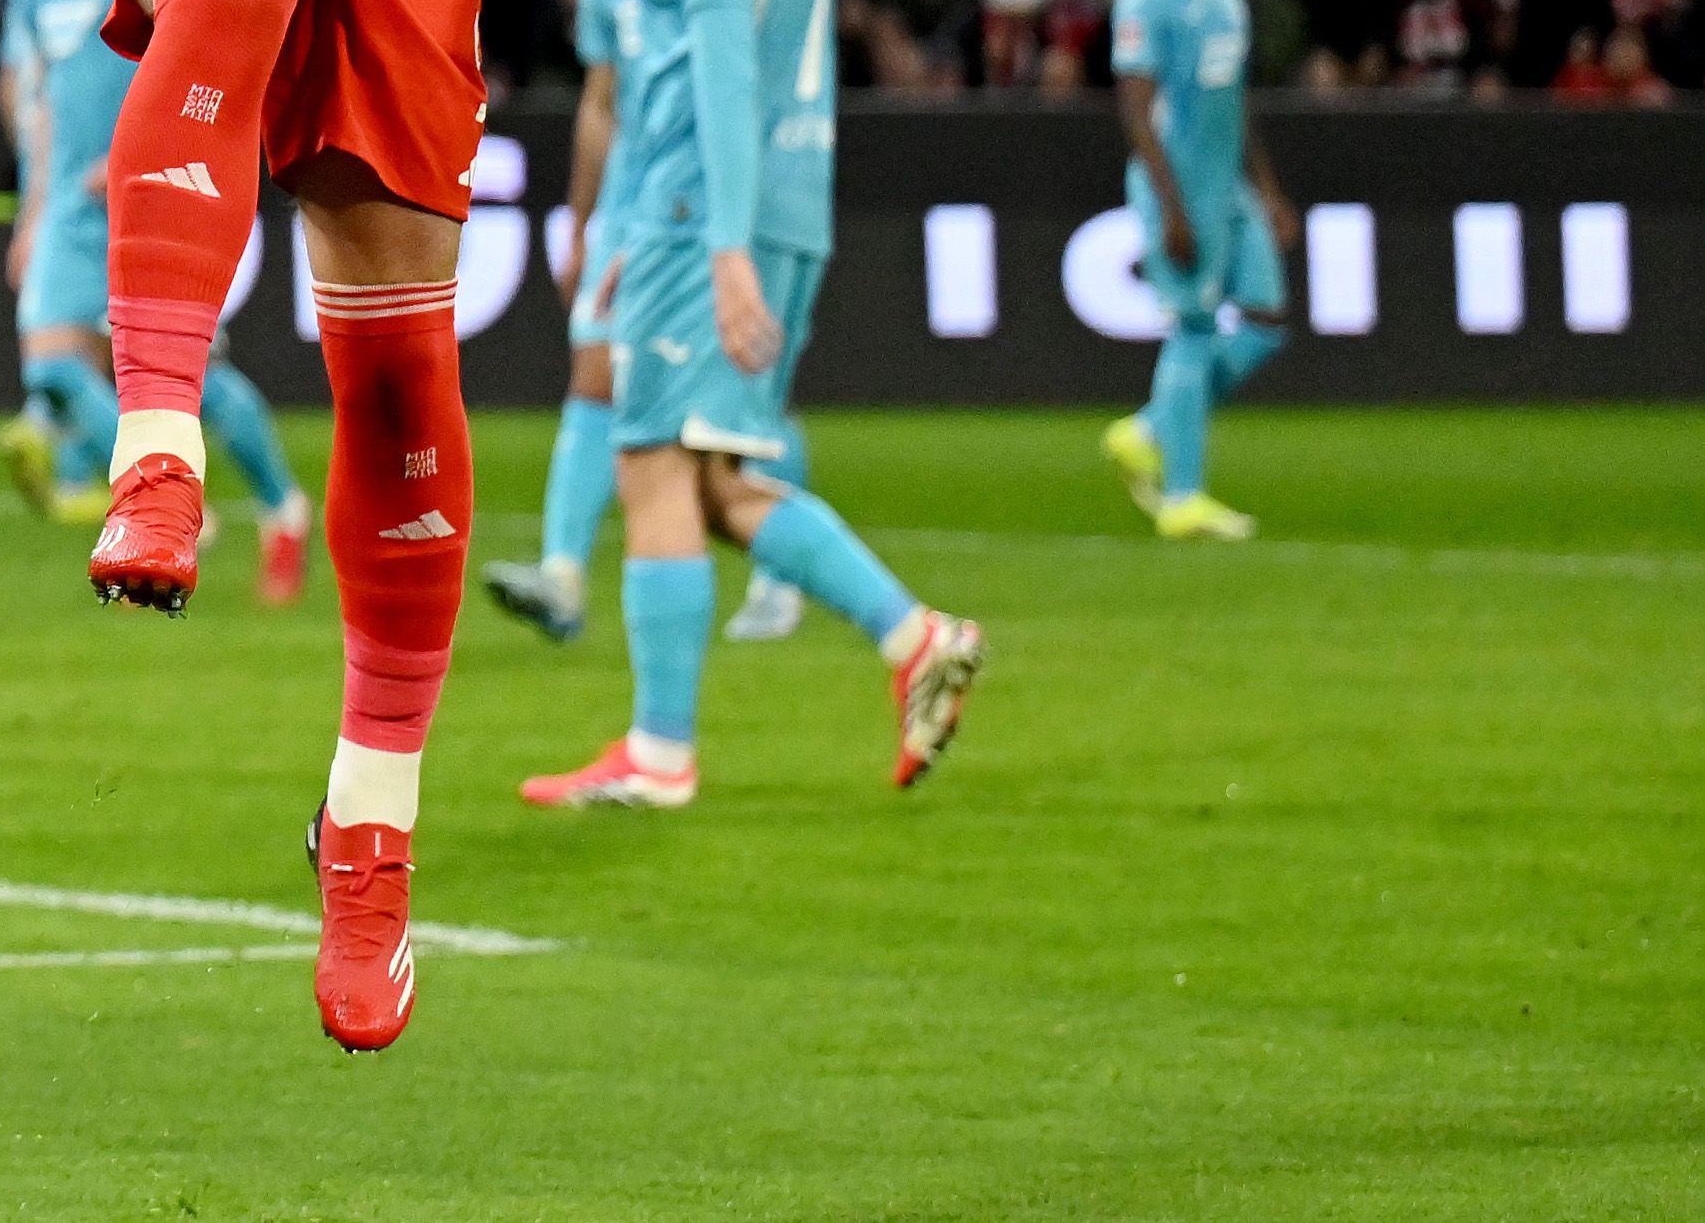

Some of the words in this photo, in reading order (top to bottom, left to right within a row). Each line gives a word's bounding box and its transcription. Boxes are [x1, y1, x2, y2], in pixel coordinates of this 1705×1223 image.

[188, 83, 224, 100] MIA
[184, 95, 220, 114] SAN
[180, 105, 216, 125] MIA
[406, 446, 437, 461] MIA
